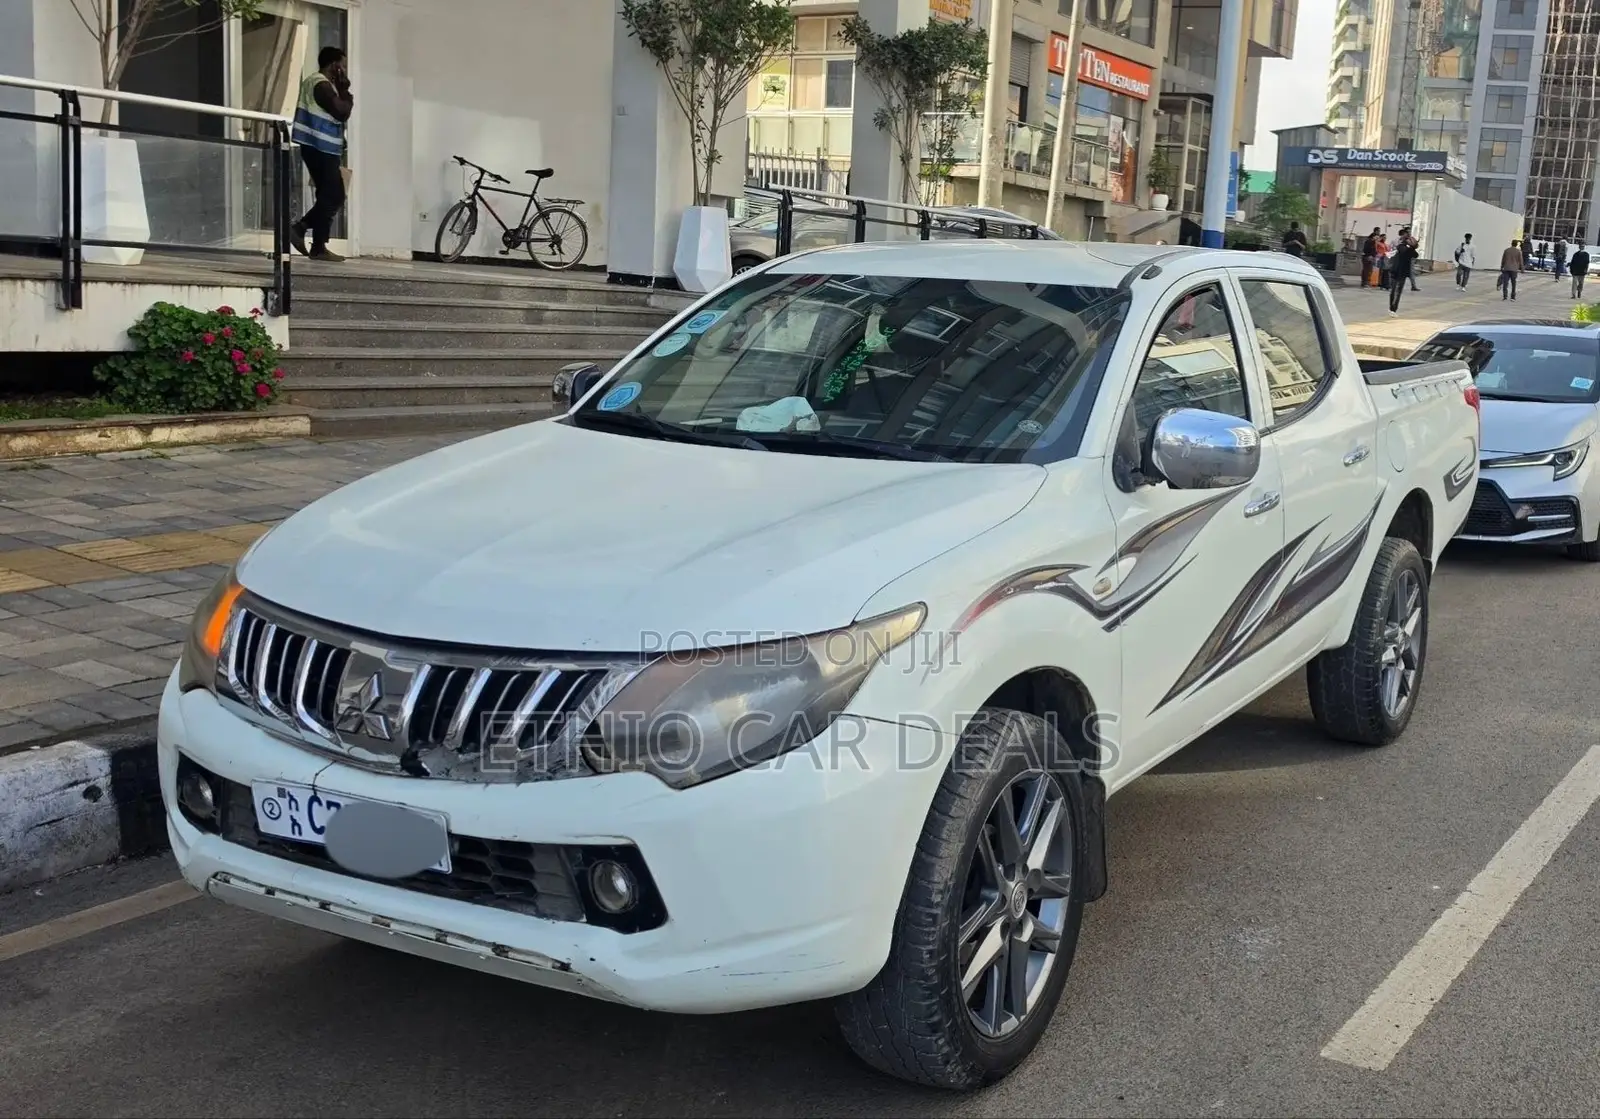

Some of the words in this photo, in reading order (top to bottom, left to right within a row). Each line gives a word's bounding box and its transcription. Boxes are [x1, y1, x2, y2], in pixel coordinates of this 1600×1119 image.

[1109, 72, 1150, 96] RESTAURANT
[1346, 149, 1372, 162] Dan
[1373, 150, 1417, 162] Scootz
